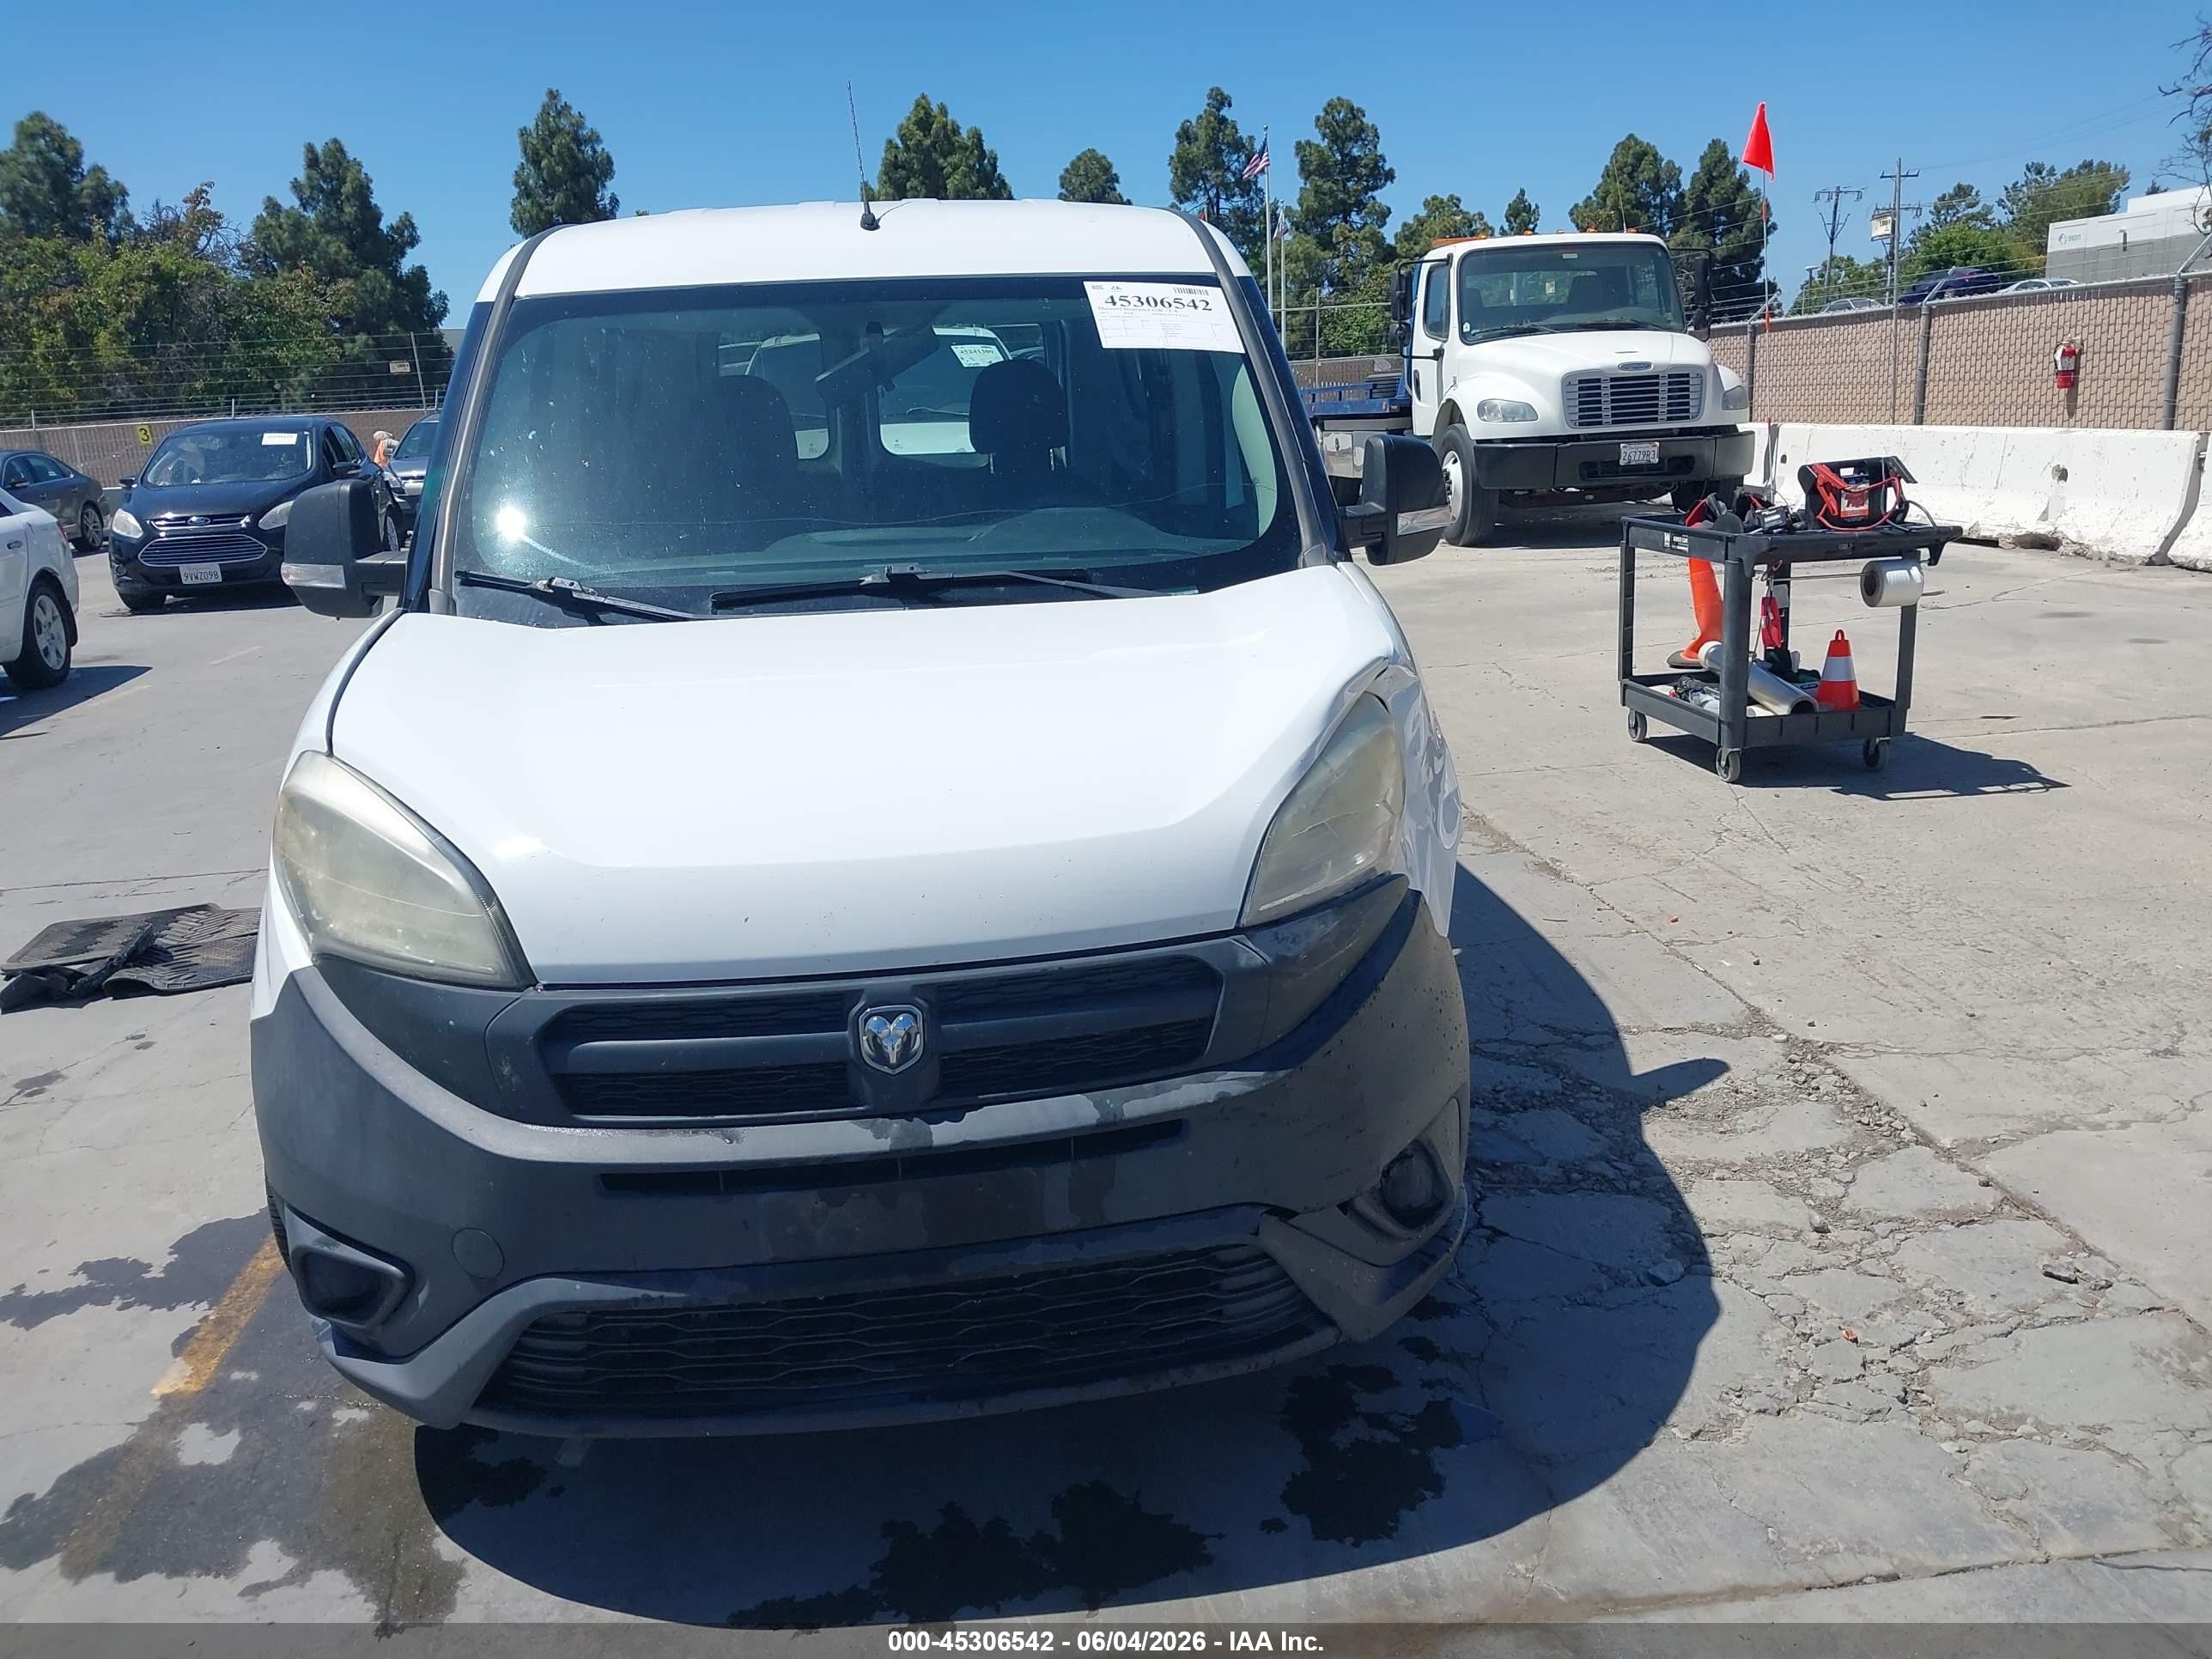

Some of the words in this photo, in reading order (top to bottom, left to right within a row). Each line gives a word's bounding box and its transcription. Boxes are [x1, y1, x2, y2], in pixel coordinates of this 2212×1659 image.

[1104, 295, 1212, 312] 45306542
[139, 428, 150, 442] 3
[183, 569, 219, 583] 9VWZ098
